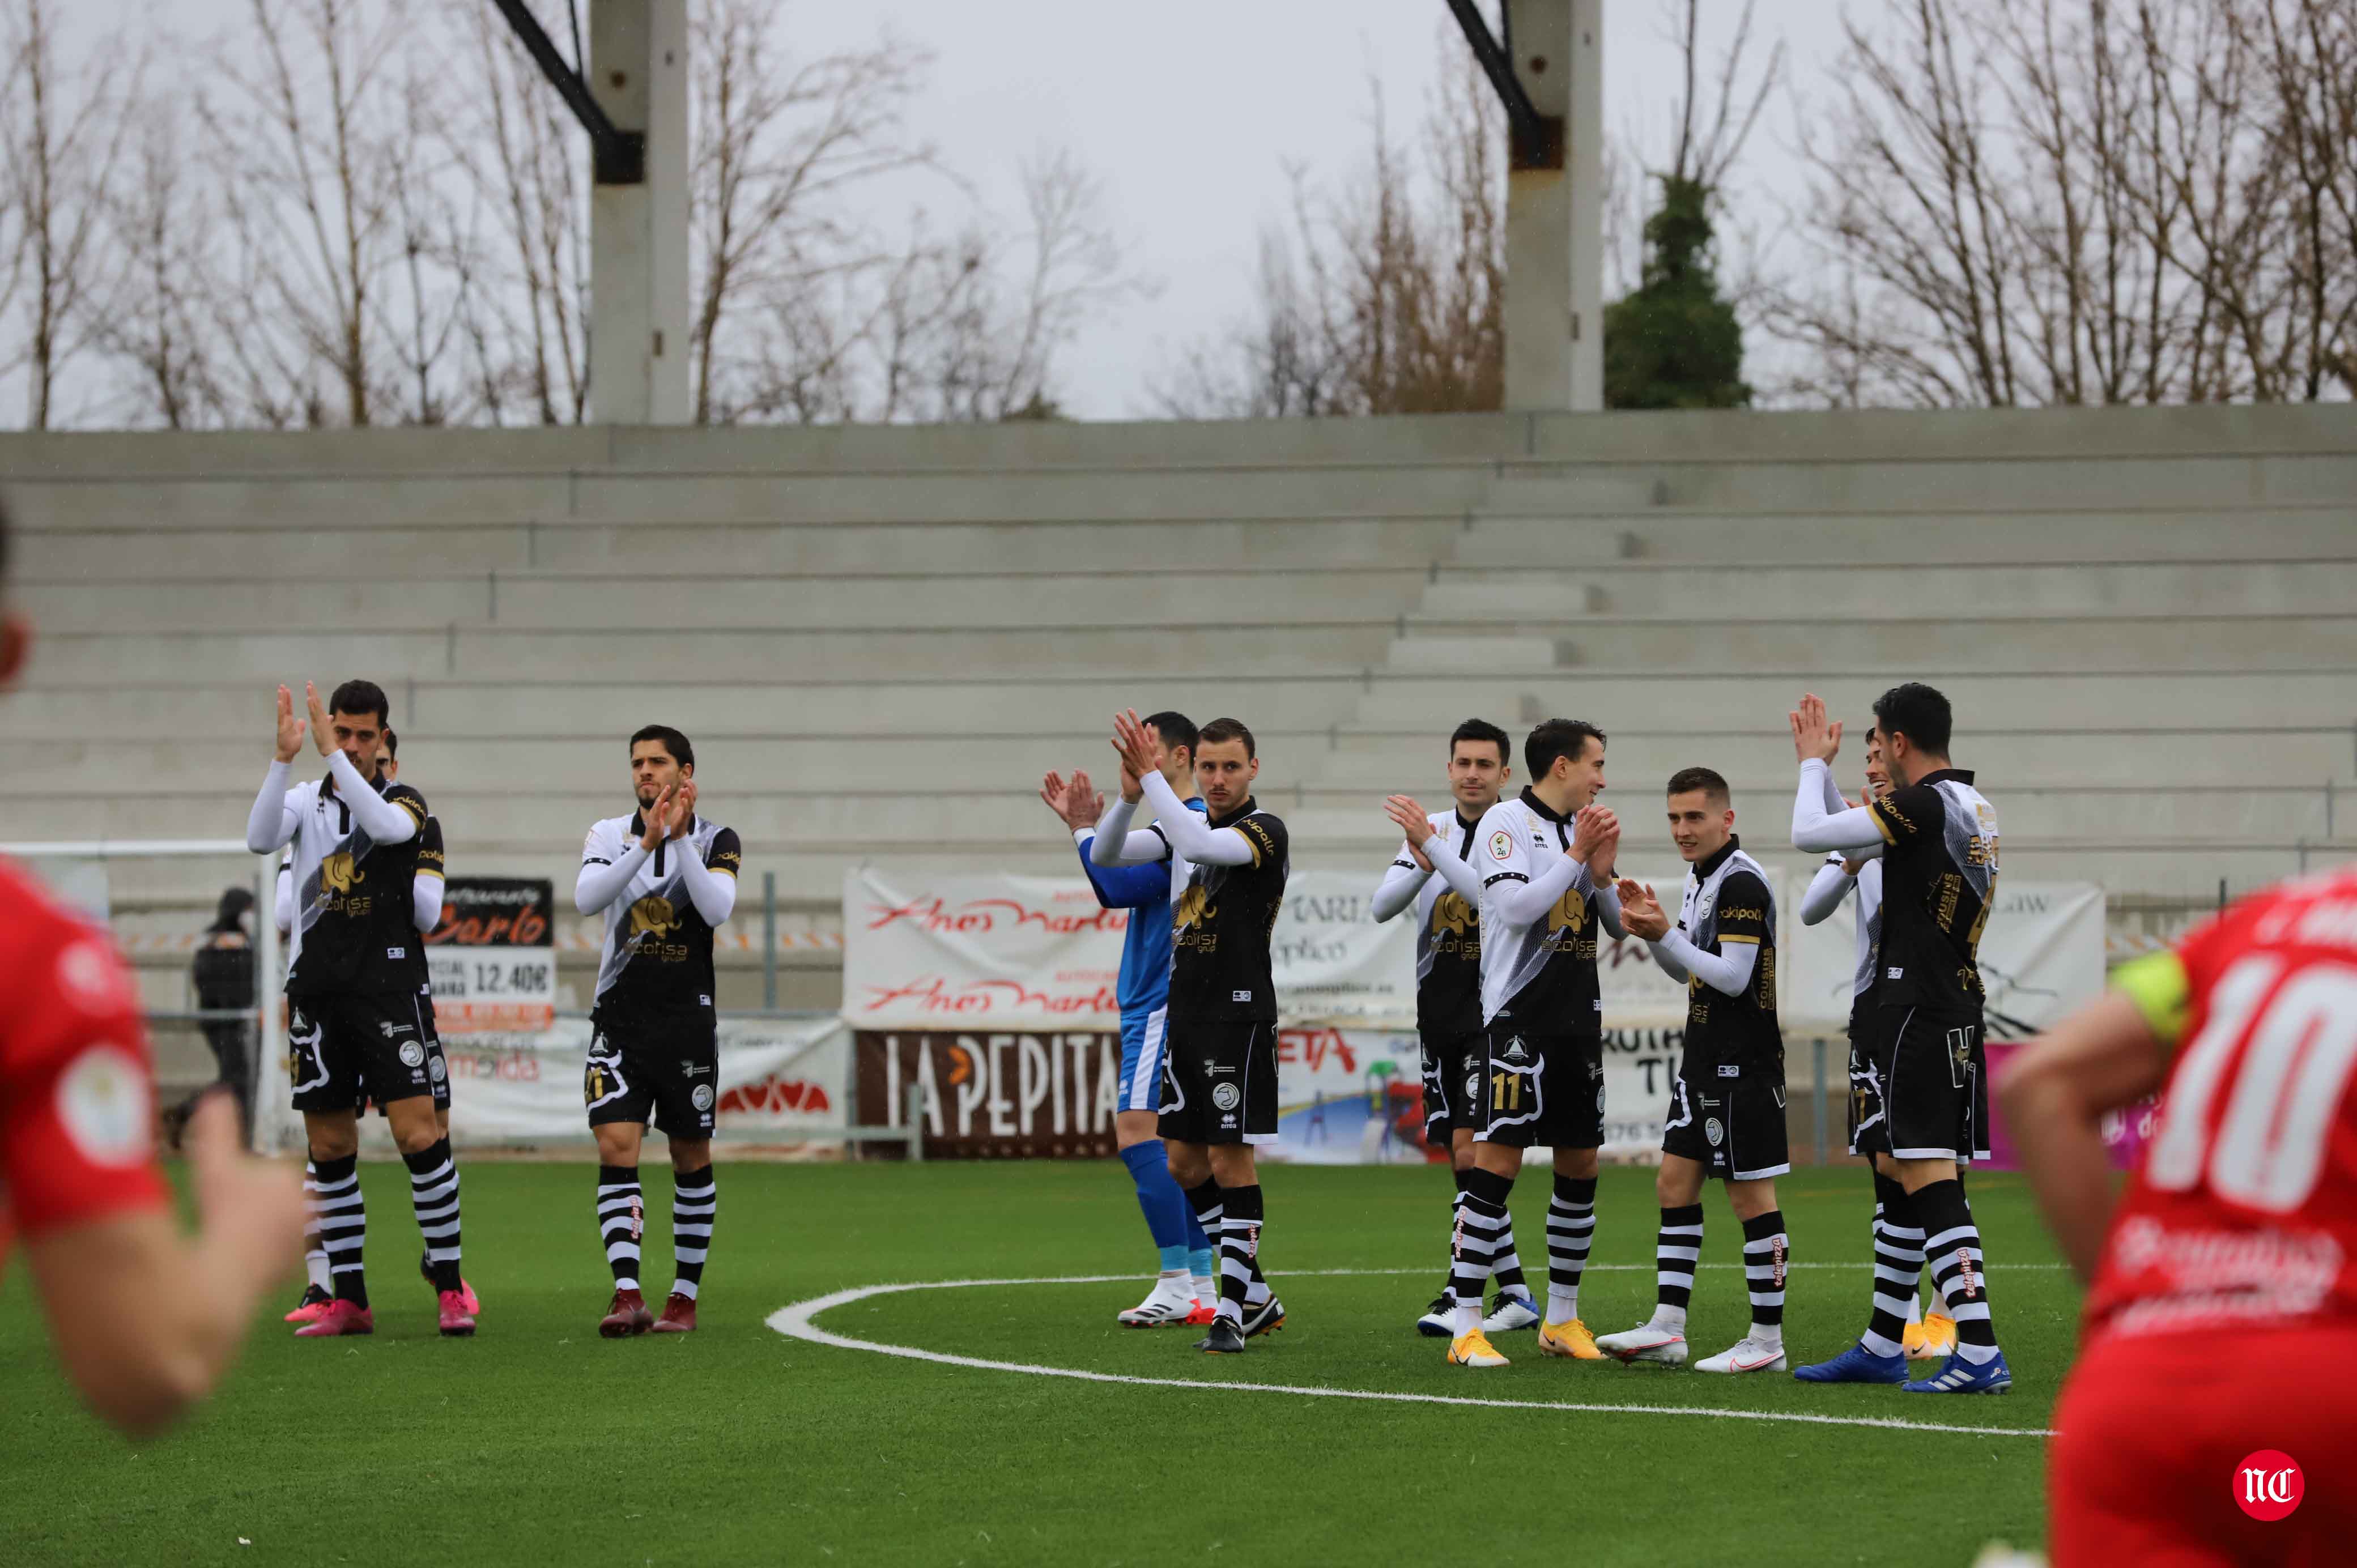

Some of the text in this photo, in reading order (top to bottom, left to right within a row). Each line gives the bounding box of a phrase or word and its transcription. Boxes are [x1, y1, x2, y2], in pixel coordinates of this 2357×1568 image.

[1492, 1072, 1520, 1110] 11
[2146, 952, 2357, 1212] 10
[1772, 1237, 1784, 1287] telepizza
[1958, 1249, 1977, 1298] telepizza
